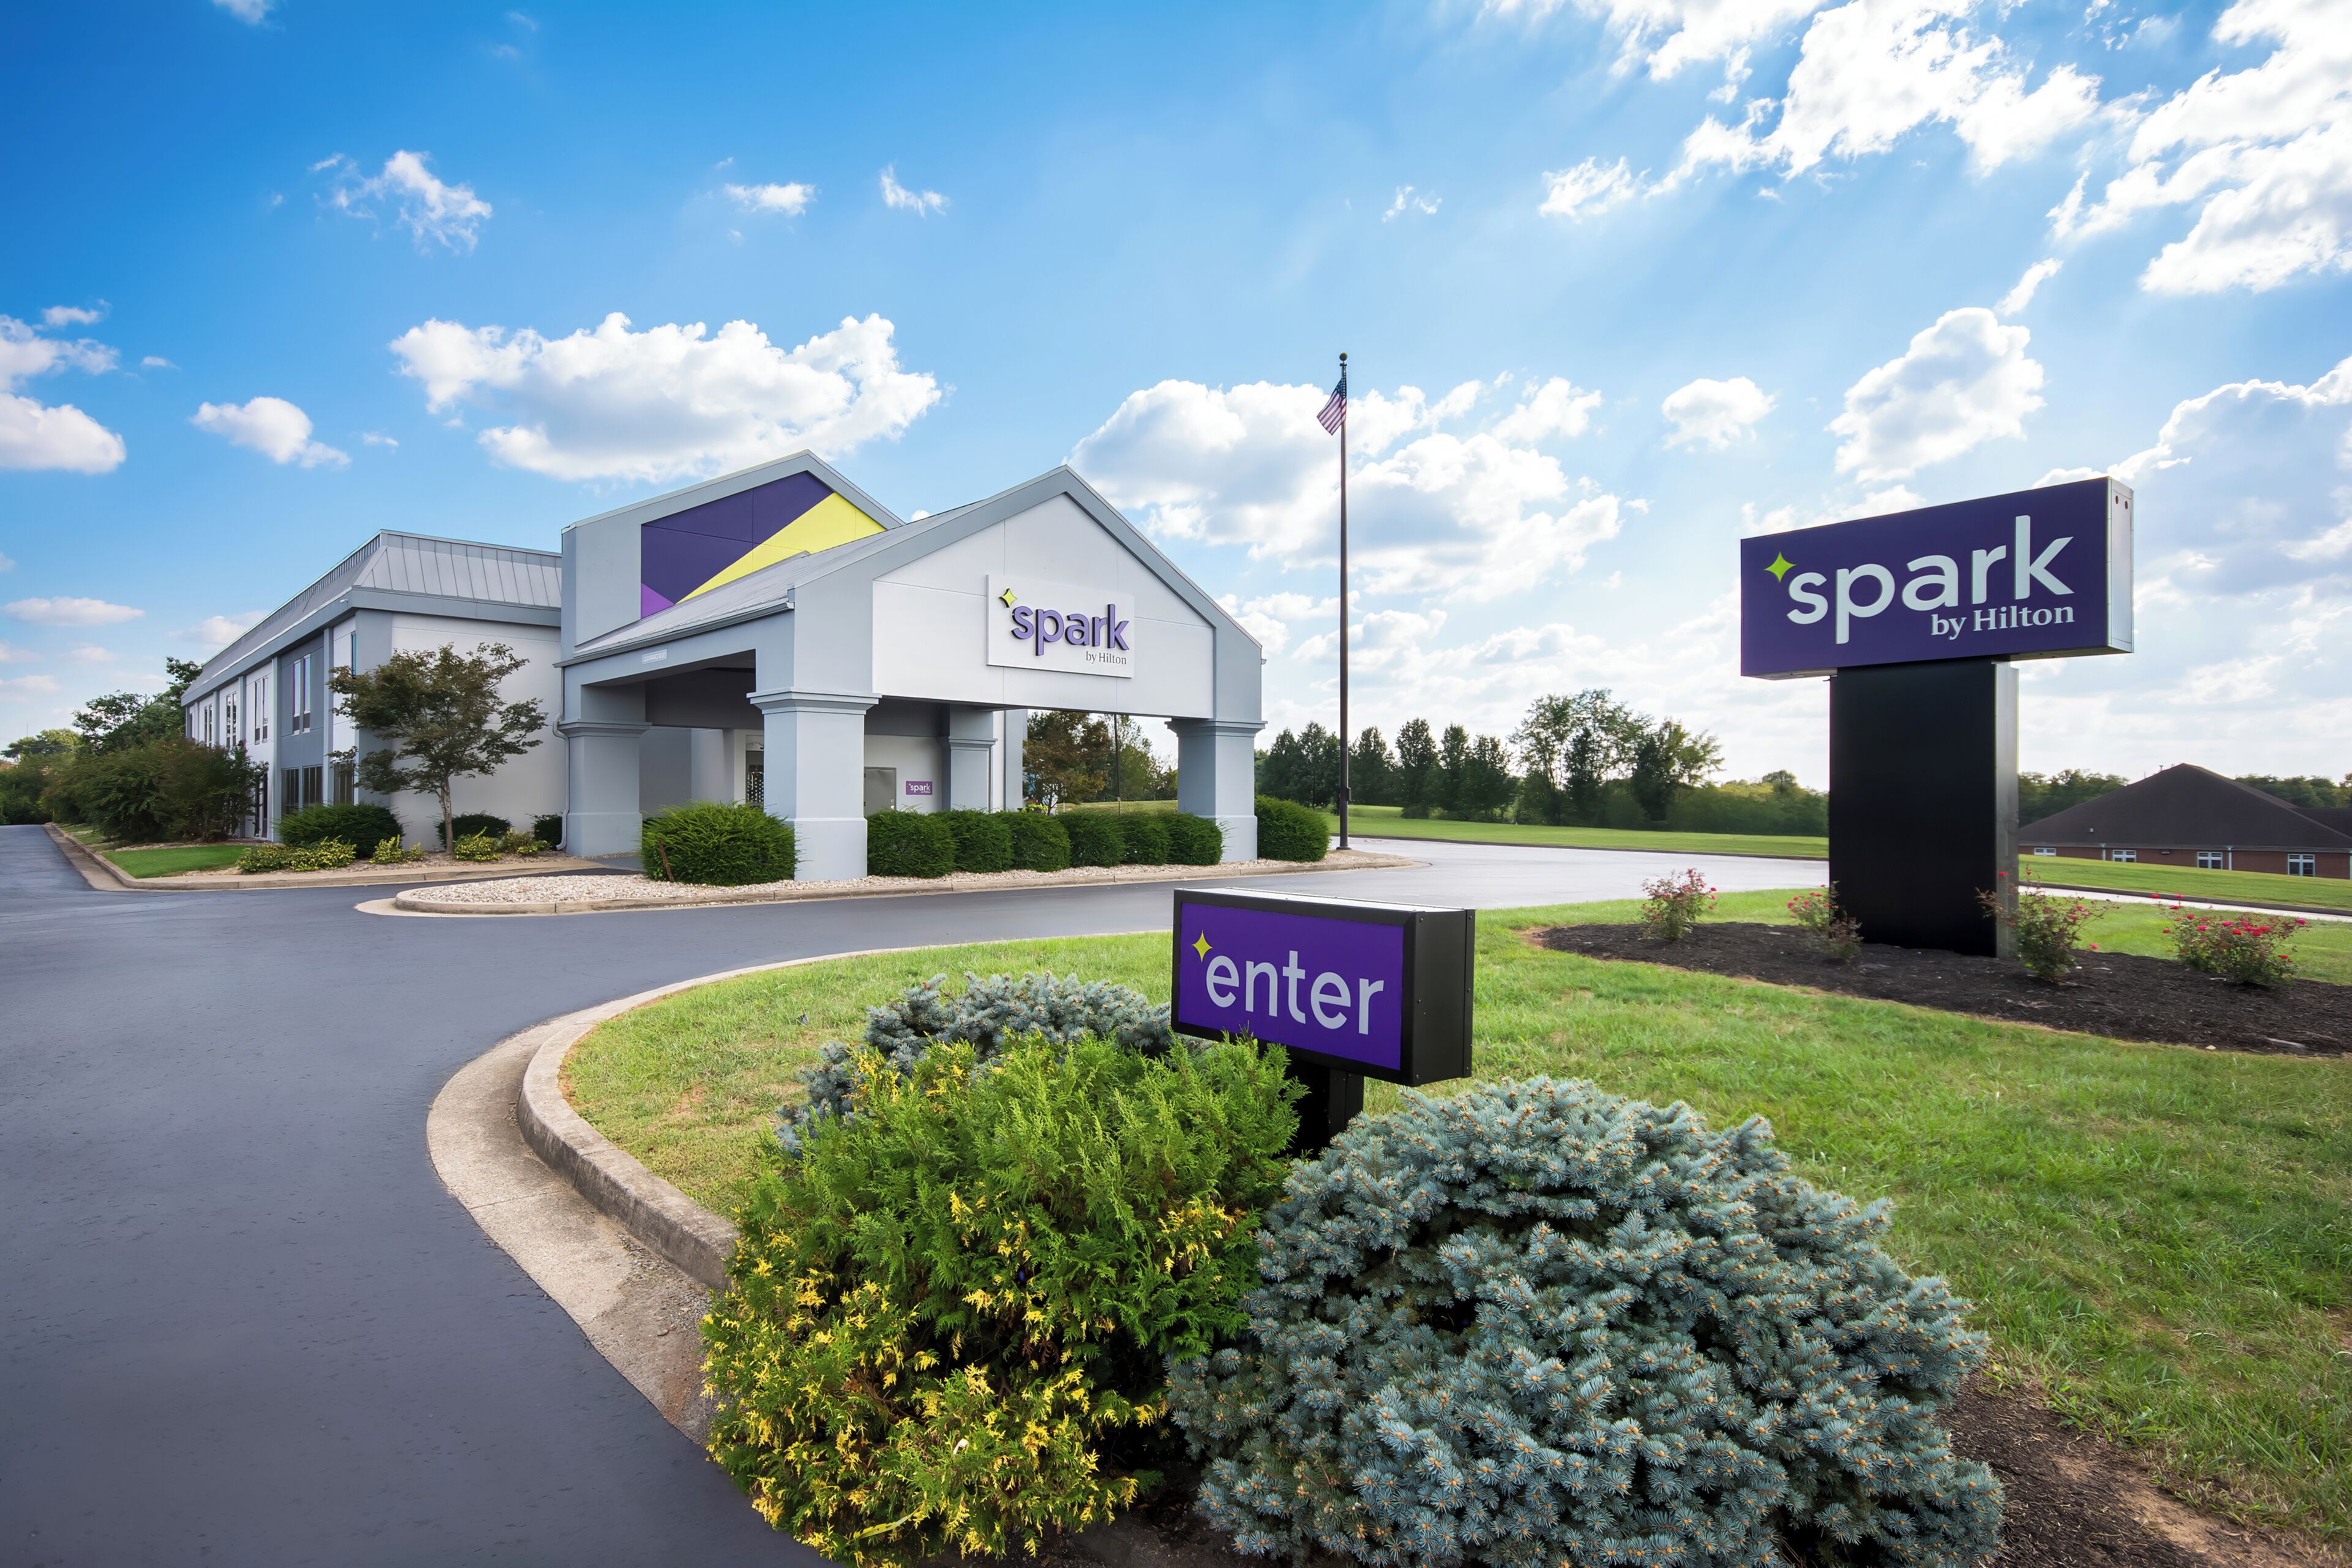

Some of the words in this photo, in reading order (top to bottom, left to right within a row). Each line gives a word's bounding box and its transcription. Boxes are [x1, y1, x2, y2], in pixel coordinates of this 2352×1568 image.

[1786, 514, 2075, 644] spark
[1011, 603, 1130, 656] spark
[1931, 613, 1967, 641] by
[1973, 605, 2075, 631] Hilton
[1086, 650, 1097, 665] by
[1099, 652, 1126, 665] Hilton
[910, 783, 931, 793] spark
[1205, 949, 1384, 1035] enter
